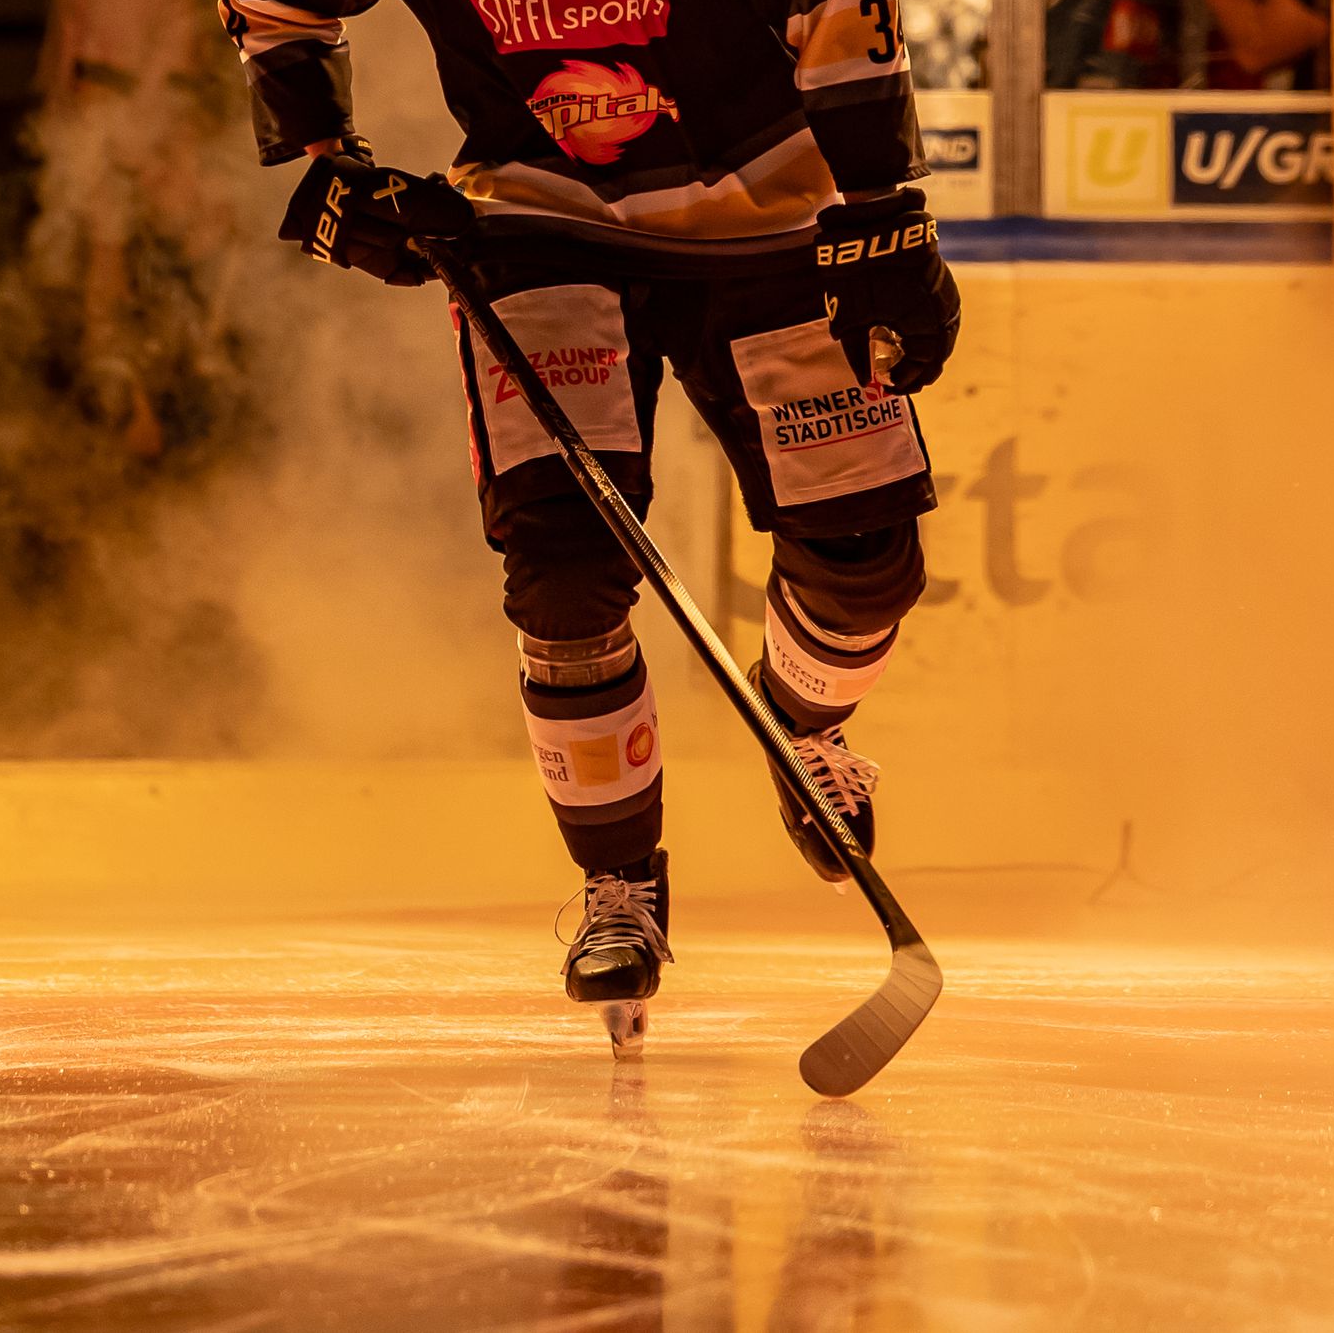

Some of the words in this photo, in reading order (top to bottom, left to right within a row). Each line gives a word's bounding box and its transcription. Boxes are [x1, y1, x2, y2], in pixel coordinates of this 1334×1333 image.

[530, 92, 577, 111] ienna
[527, 347, 619, 370] ZAUNER
[769, 386, 865, 423] WIENER
[775, 398, 902, 447] STÄDTISCHE
[534, 744, 566, 764] gen
